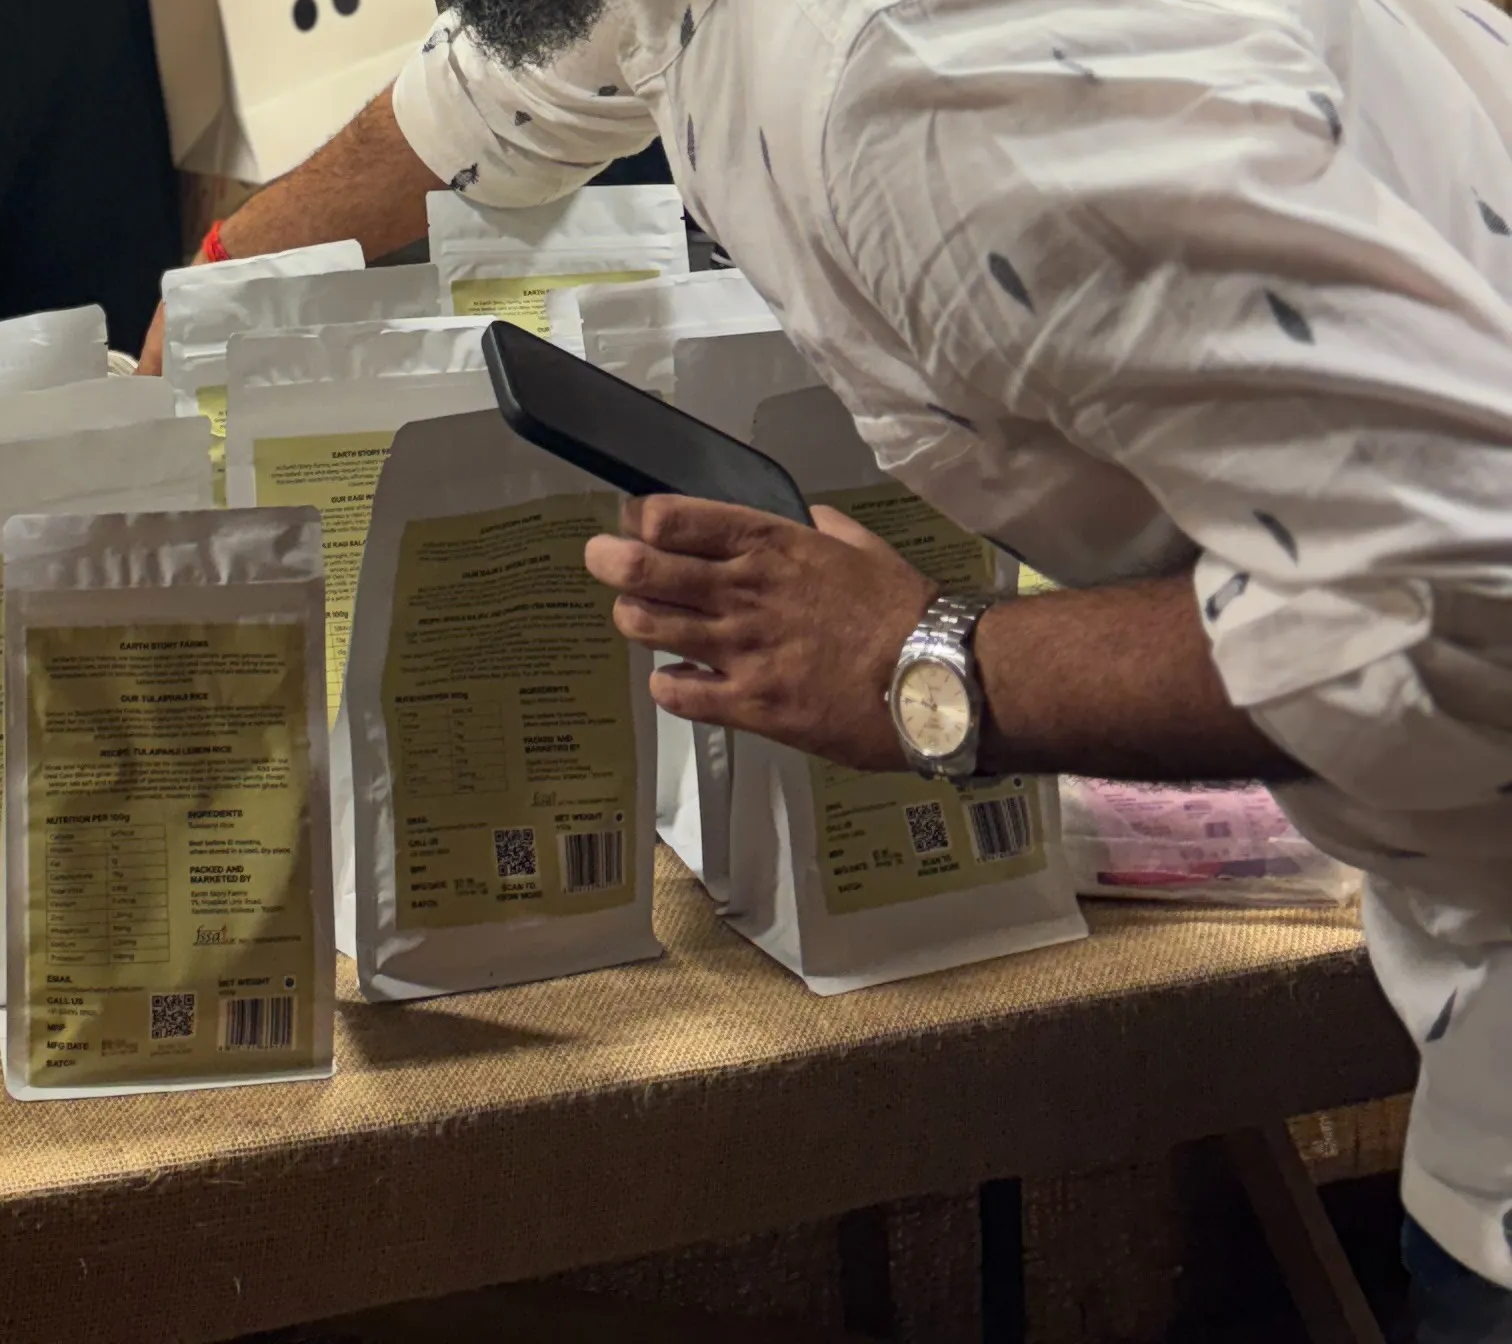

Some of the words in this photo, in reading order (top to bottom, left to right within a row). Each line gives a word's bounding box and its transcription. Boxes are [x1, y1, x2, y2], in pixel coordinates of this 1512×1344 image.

[332, 451, 357, 459] EARTH
[357, 449, 380, 458] STORY
[331, 496, 347, 504] OUR
[347, 495, 365, 503] RAGI
[120, 642, 150, 651] EARTH
[150, 641, 178, 650] STORY
[179, 640, 209, 649] FARMS
[120, 694, 139, 703] OUR
[189, 692, 209, 701] RICE
[46, 814, 91, 825] NUTRITION
[91, 813, 108, 823] PER
[109, 813, 131, 824] 100g
[187, 810, 244, 819] INGREDIENTS
[189, 865, 224, 874] PACKED
[225, 864, 245, 873] AND
[190, 874, 239, 884] MARKETED
[239, 874, 252, 884] BY
[46, 974, 73, 984] EMAIL
[46, 996, 70, 1006] CALL
[70, 996, 84, 1006] US
[47, 1041, 65, 1051] MFG
[66, 1041, 89, 1051] DATE
